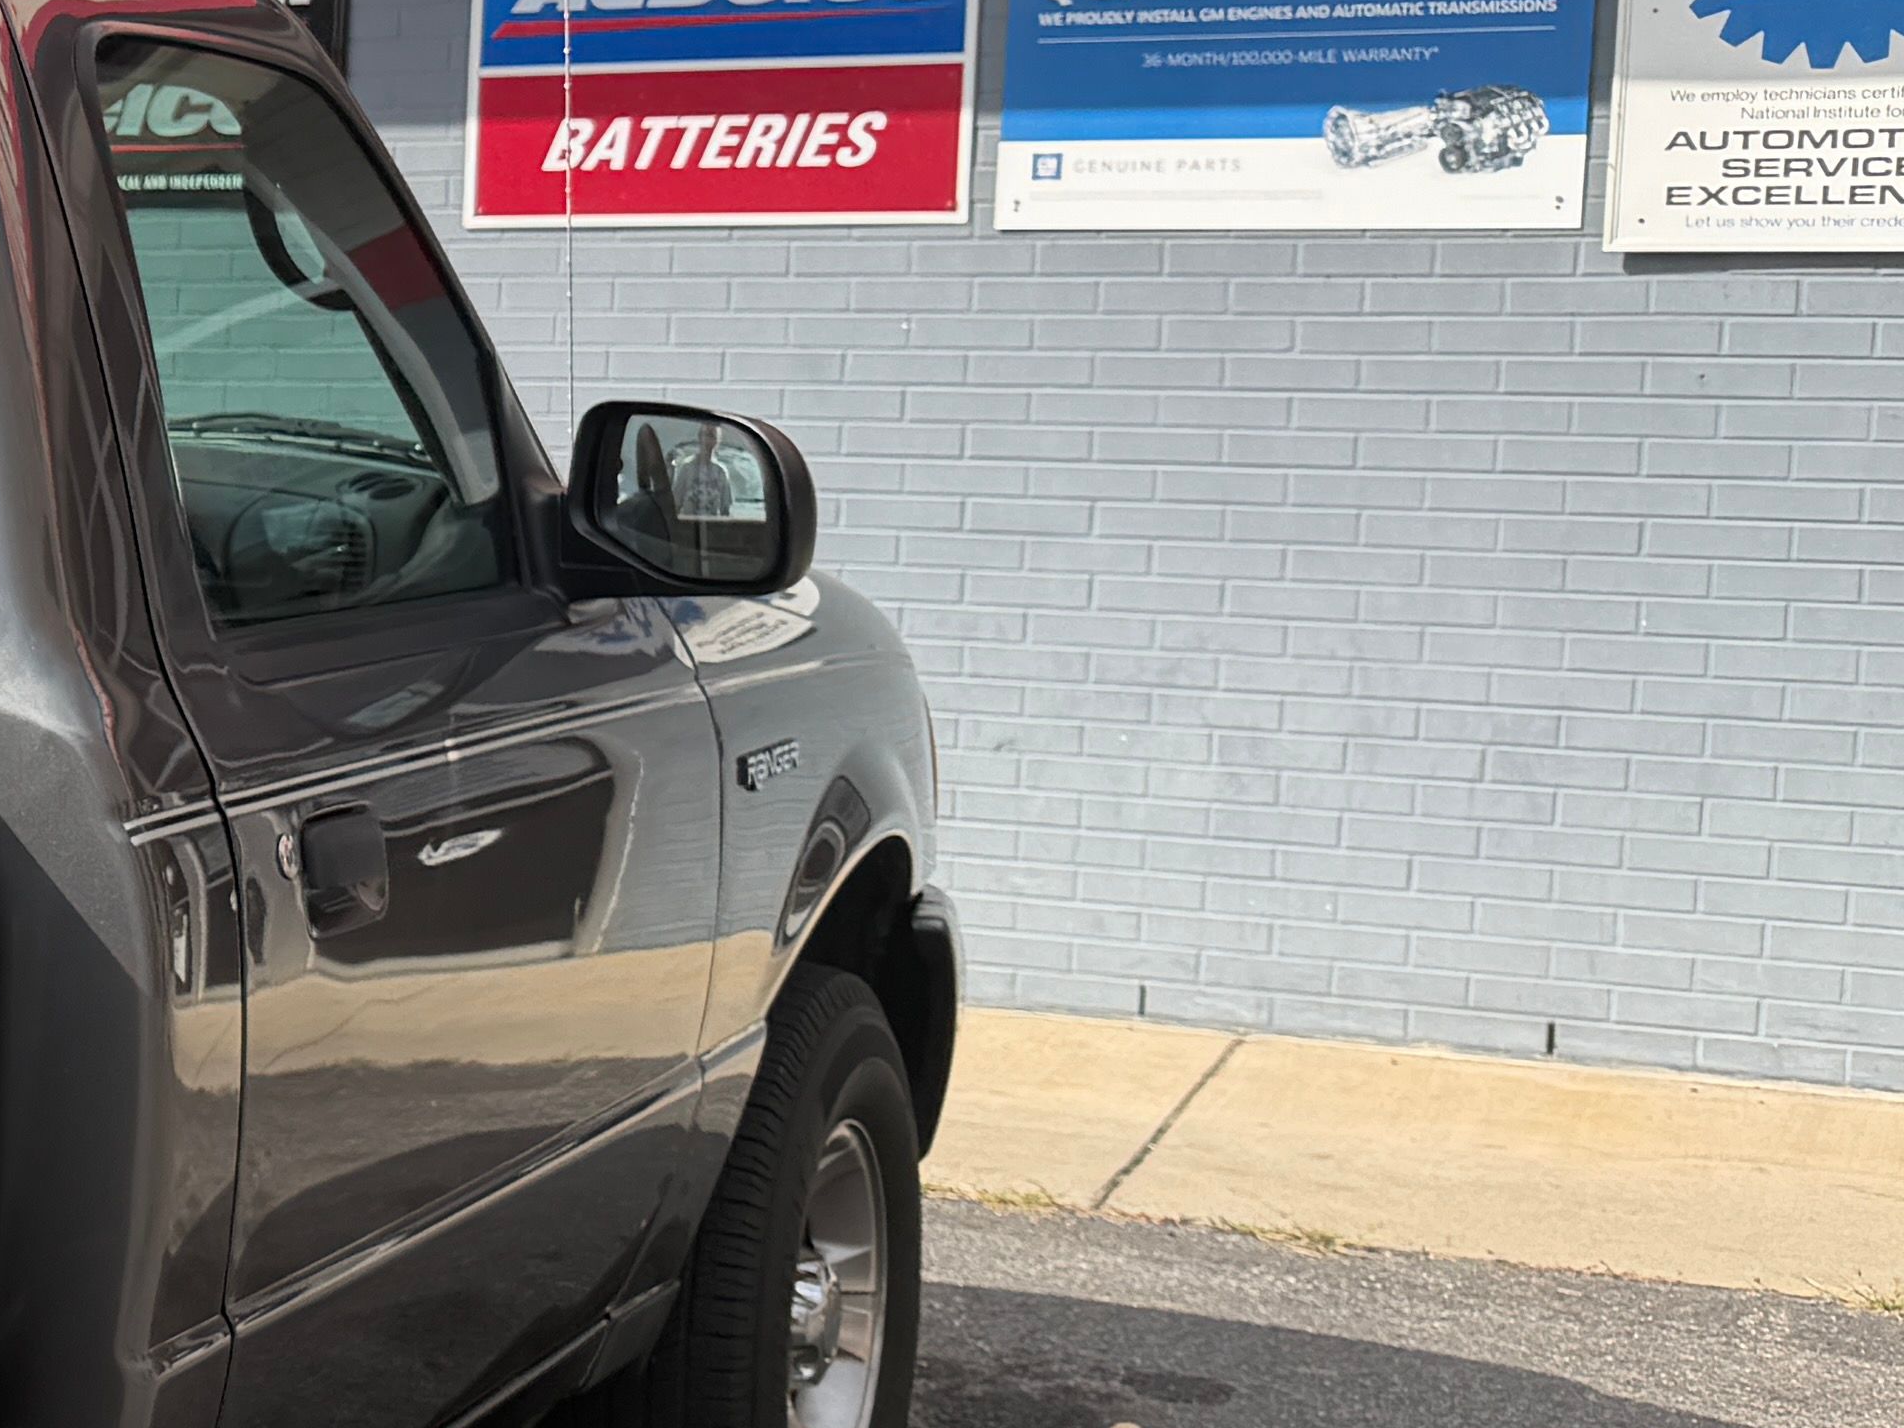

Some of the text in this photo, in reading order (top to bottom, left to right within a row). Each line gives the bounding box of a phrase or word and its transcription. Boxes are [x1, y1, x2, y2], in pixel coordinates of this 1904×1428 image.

[1066, 9, 1135, 25] PROUDLY
[1137, 9, 1197, 24] INSTALL
[1199, 7, 1225, 22] GM
[1227, 5, 1292, 21] ENGINES
[1295, 4, 1330, 20] AND
[1332, 2, 1425, 18] AUTOMATIC
[1670, 88, 1696, 102] We
[1700, 88, 1759, 104] employ
[1764, 85, 1857, 101] technicians
[1740, 104, 1904, 120] National Institute fo
[541, 111, 887, 173] BATTERIES
[1685, 215, 1711, 228] Let
[1716, 217, 1735, 228] us
[1740, 214, 1783, 228] show
[1786, 216, 1816, 230] you
[1821, 214, 1855, 228] their
[747, 741, 799, 791] RANGER
